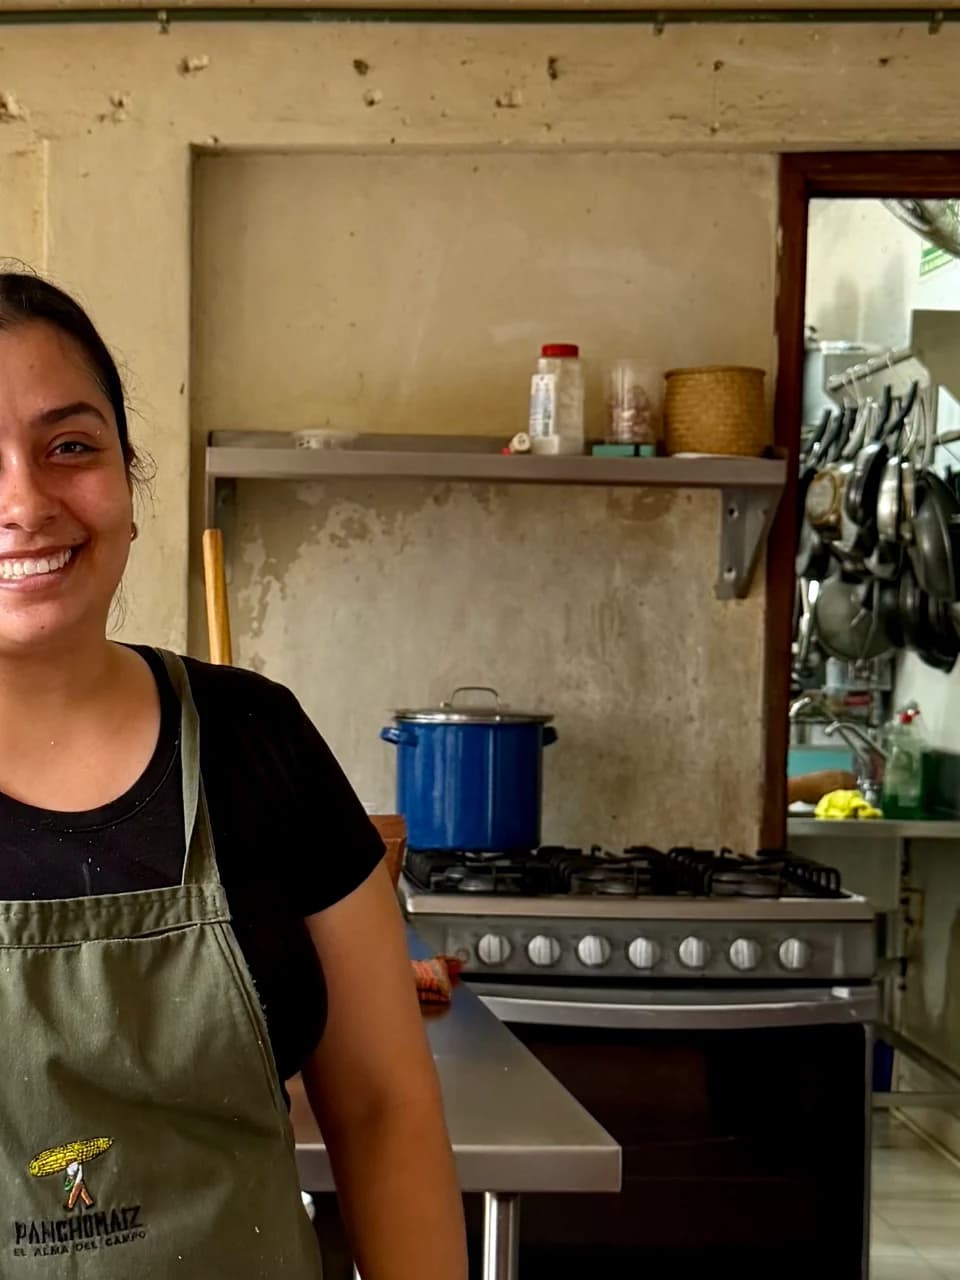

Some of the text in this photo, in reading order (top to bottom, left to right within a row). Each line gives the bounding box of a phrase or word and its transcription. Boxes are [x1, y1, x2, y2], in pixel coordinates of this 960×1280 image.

[15, 1206, 143, 1245] PANCHOMAIZ
[14, 1230, 146, 1257] EL ALMA DEL CAMPO
